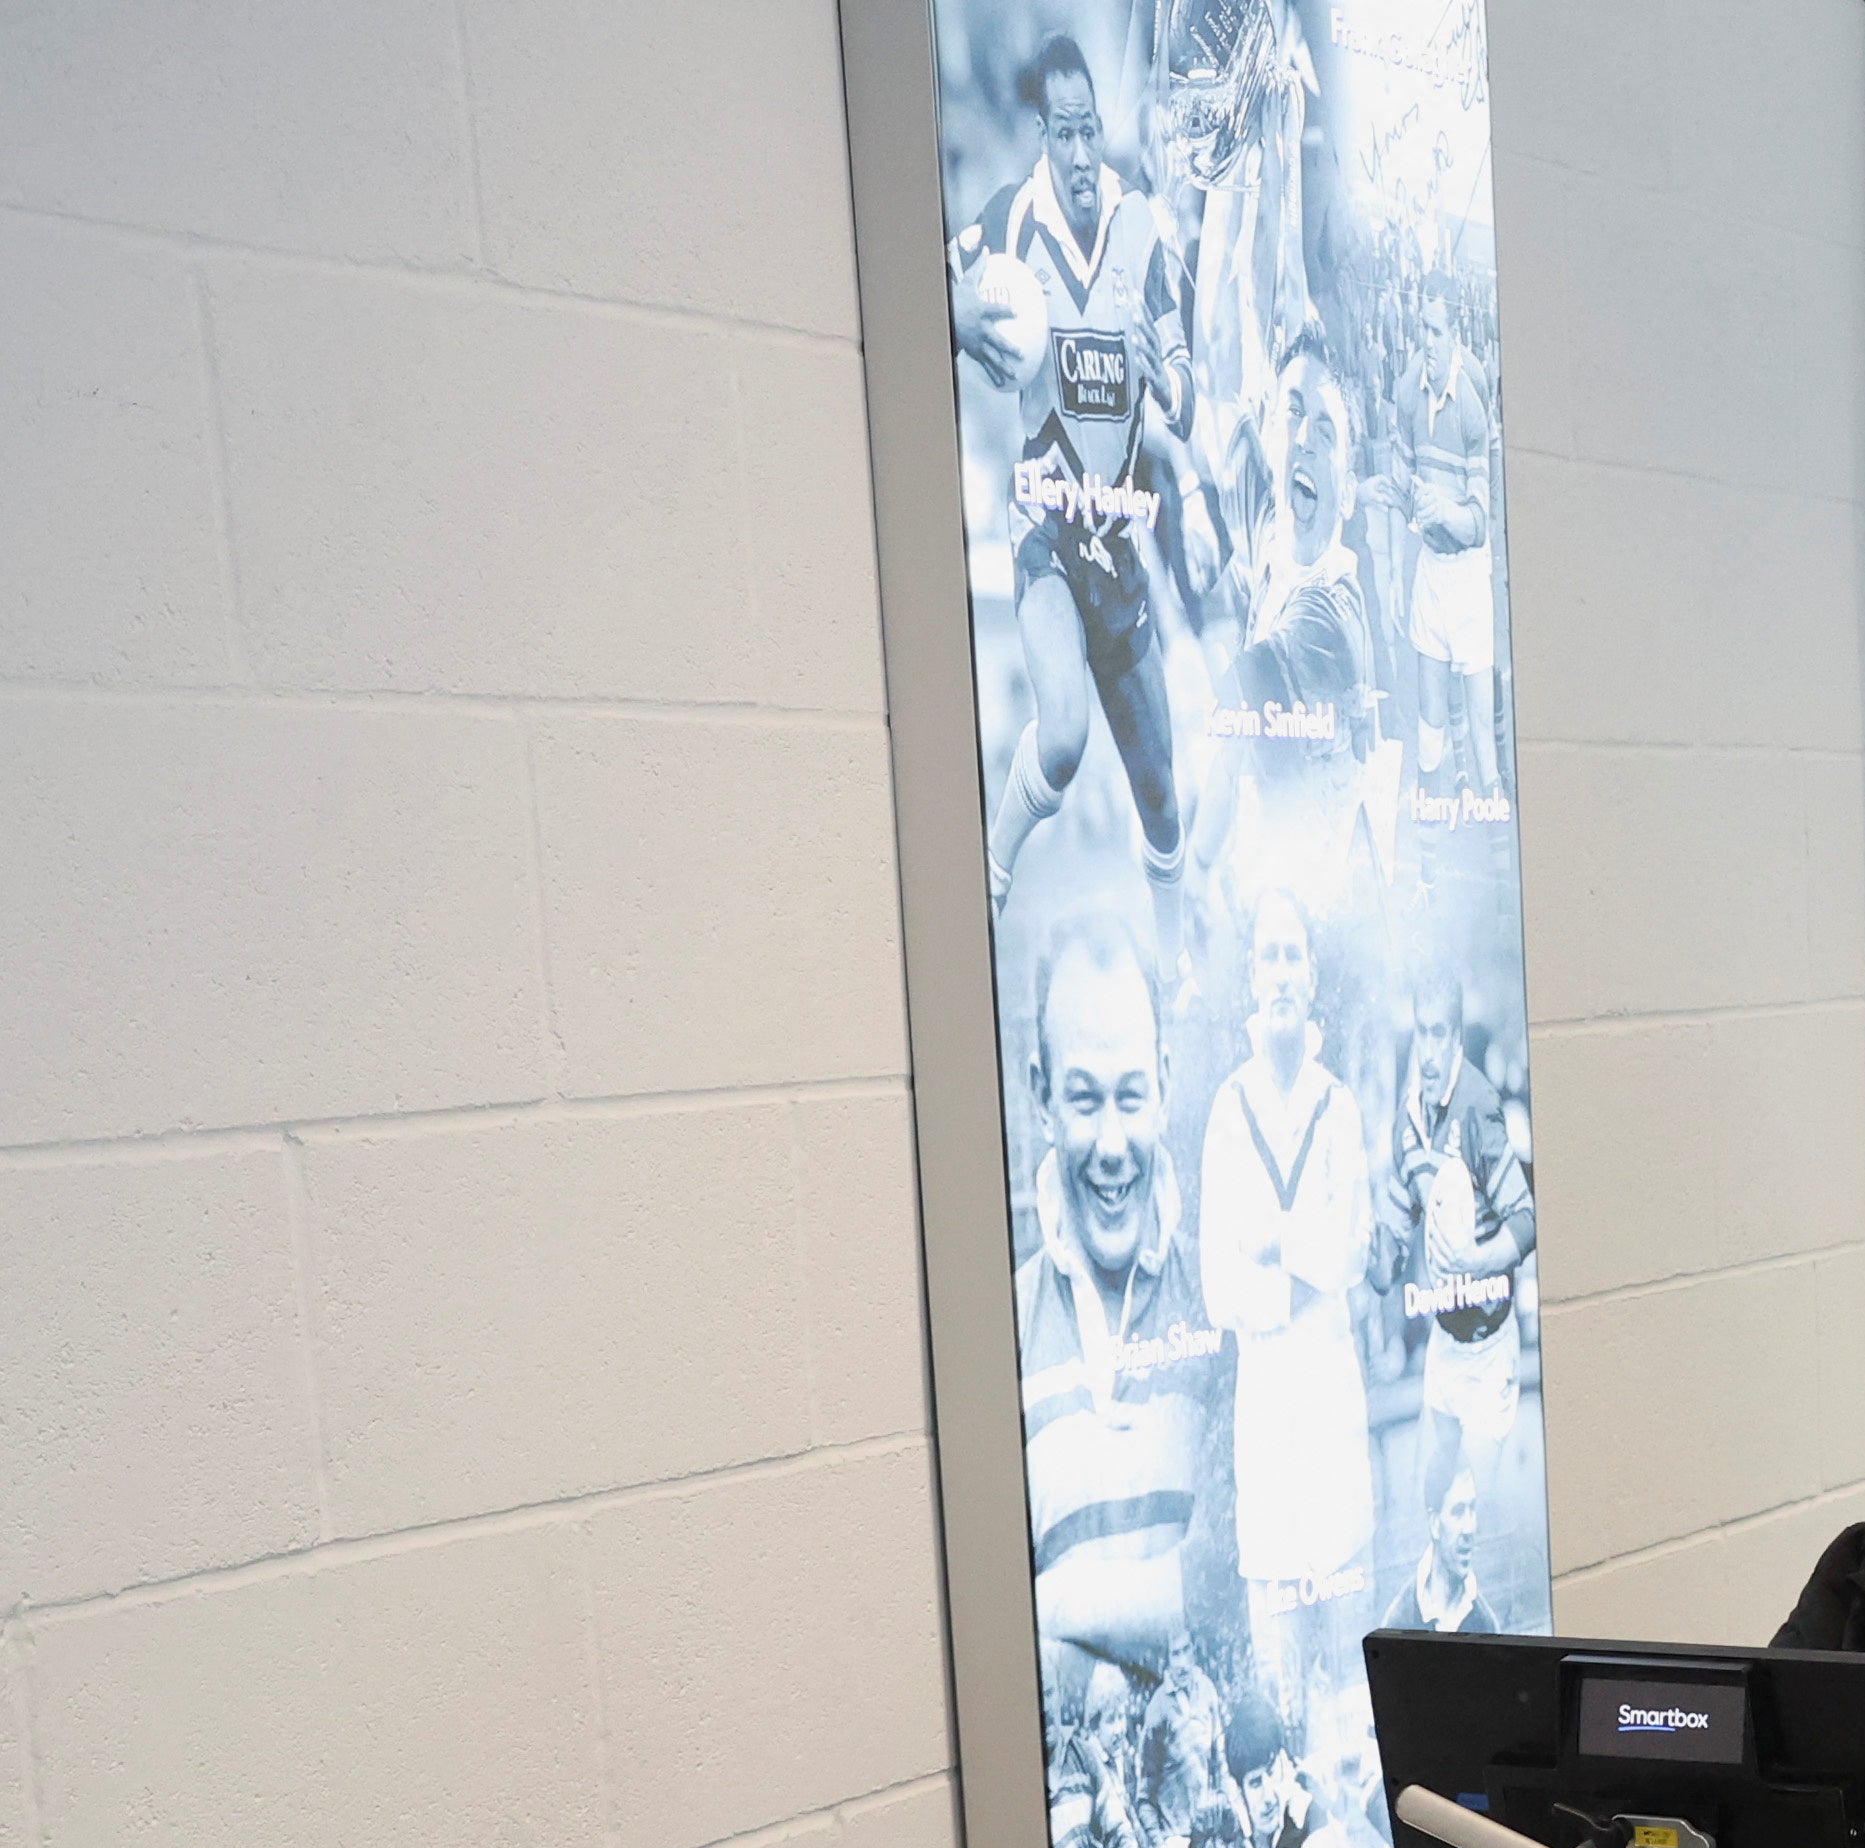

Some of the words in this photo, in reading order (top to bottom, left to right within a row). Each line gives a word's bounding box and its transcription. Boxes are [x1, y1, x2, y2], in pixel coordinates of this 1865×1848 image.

[1014, 456, 1079, 522] Ellery
[1083, 472, 1161, 528] Hanley
[1263, 700, 1336, 741] Sinfield
[1410, 788, 1459, 830] Harry
[1461, 787, 1511, 824] Poole
[1404, 1278, 1457, 1318] David
[1455, 1272, 1509, 1309] Heron
[1167, 1320, 1222, 1362] Shaw
[1618, 1704, 1709, 1730] Smartbox
